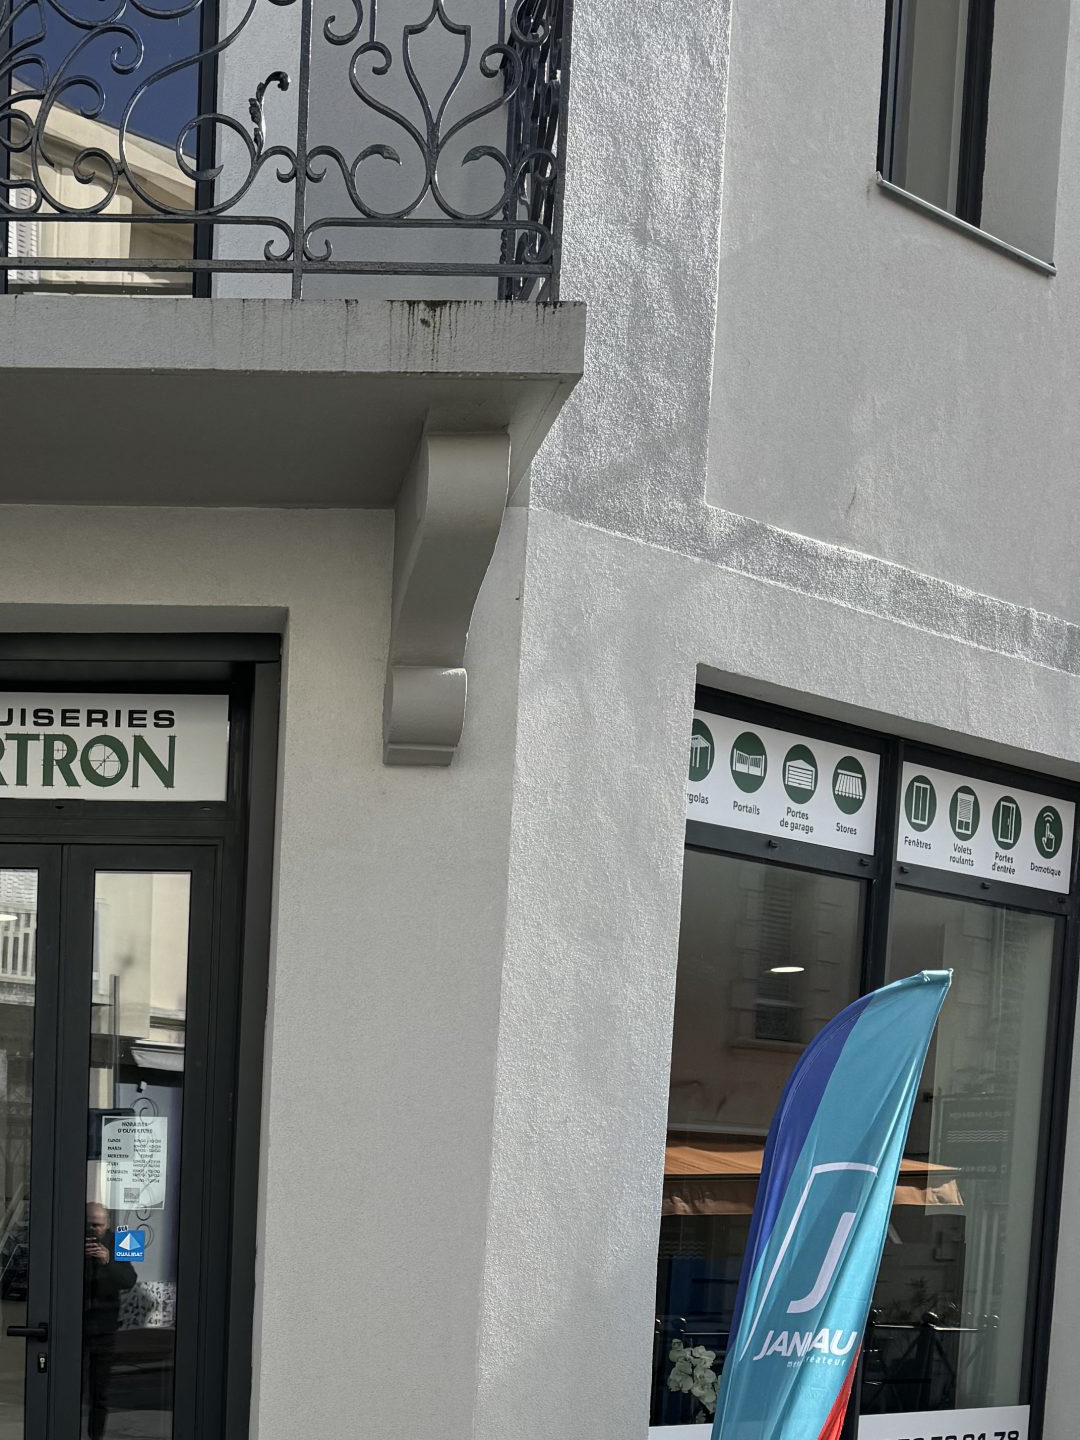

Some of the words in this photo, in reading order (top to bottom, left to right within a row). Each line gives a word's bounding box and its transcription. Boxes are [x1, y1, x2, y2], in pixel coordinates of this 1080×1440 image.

[732, 800, 761, 816] Portails
[786, 806, 809, 820] Portes
[779, 817, 789, 828] de
[789, 821, 814, 835] garage
[835, 822, 857, 836] Stores
[903, 836, 932, 851] Fenêtres
[953, 843, 972, 856] Volets
[949, 855, 974, 868] roulants
[994, 851, 1014, 864] Portes
[991, 861, 1016, 876] d'entrée
[1030, 862, 1062, 878] Domotique
